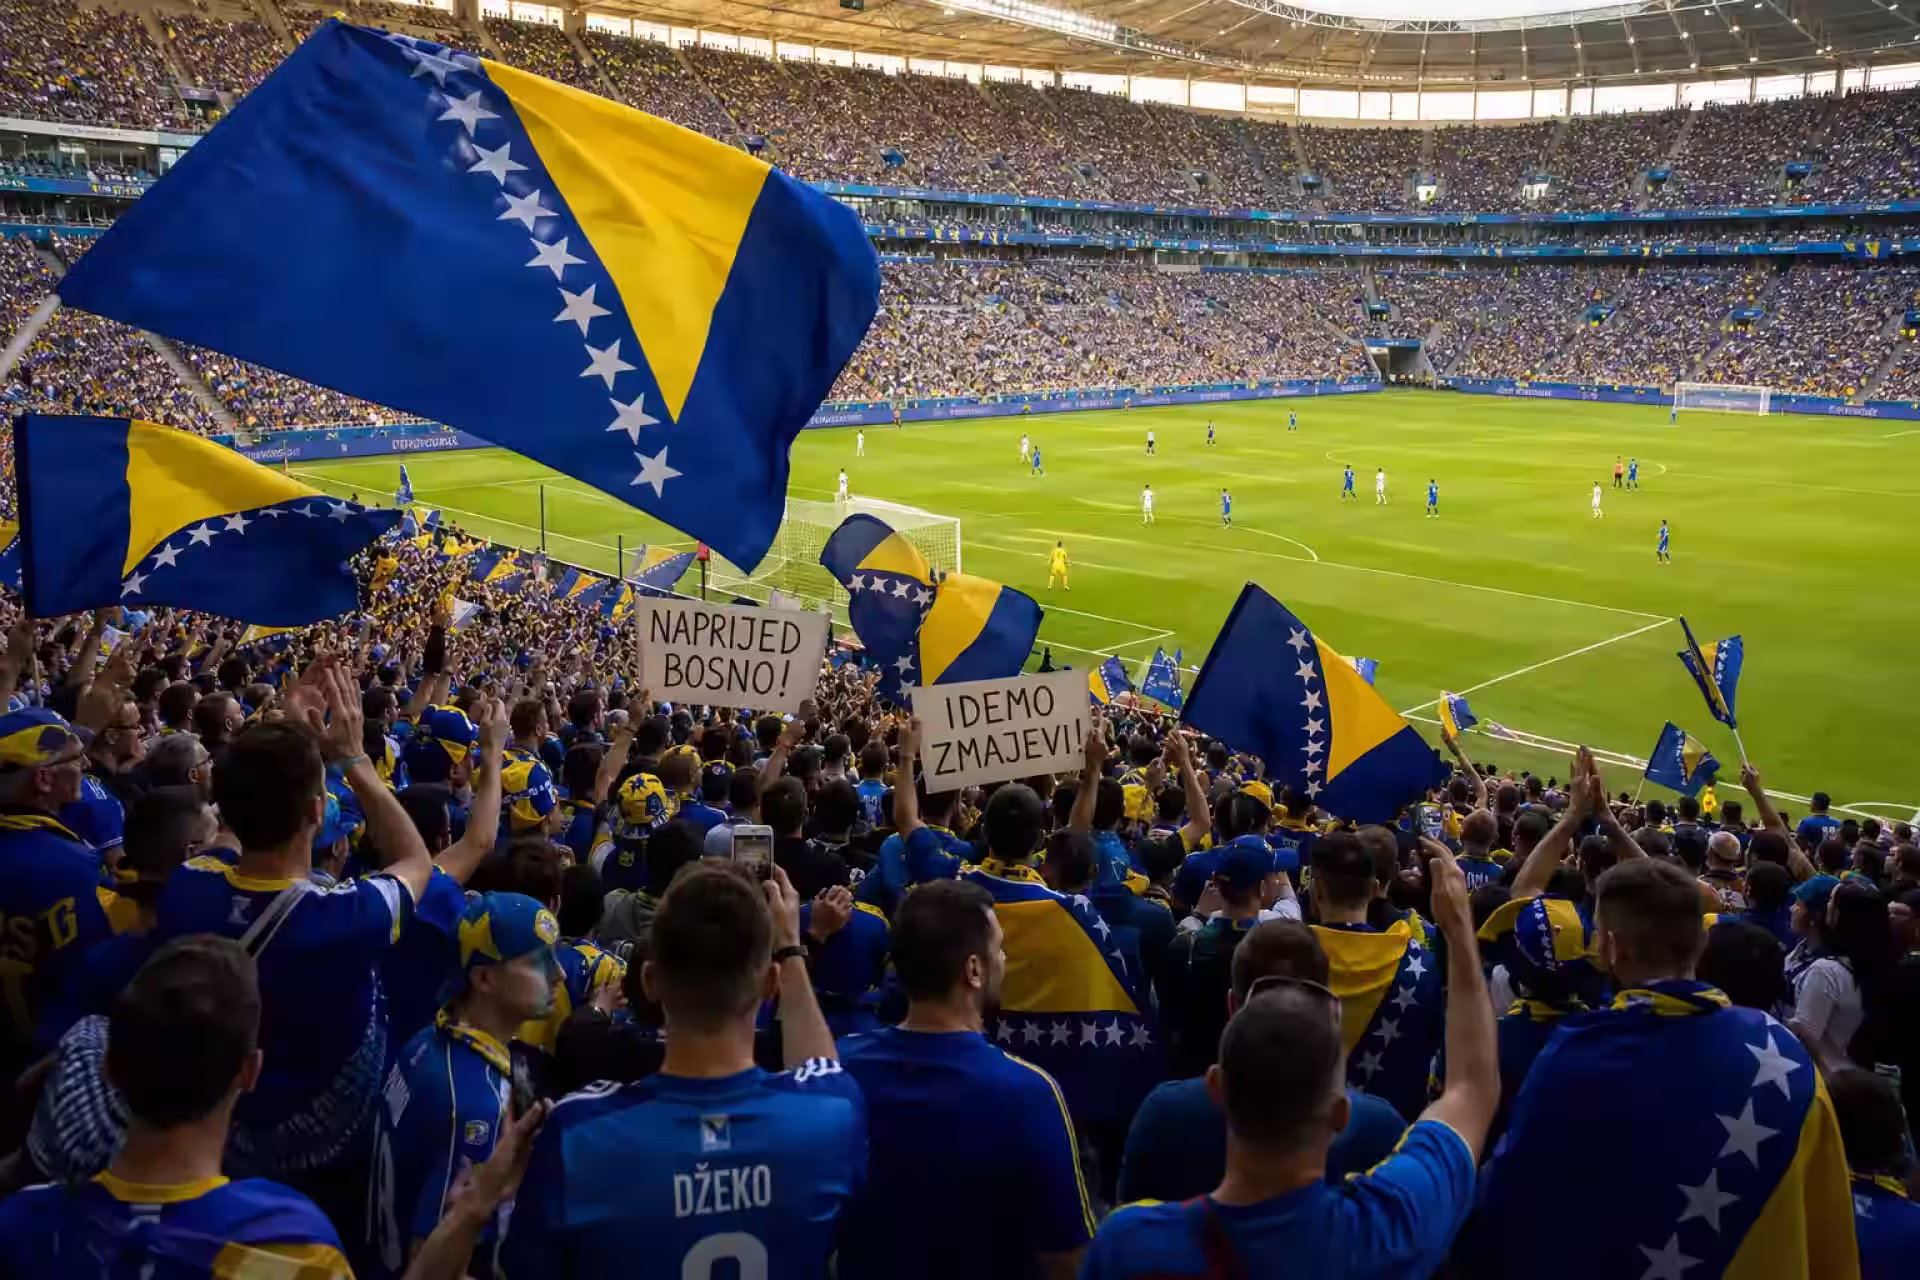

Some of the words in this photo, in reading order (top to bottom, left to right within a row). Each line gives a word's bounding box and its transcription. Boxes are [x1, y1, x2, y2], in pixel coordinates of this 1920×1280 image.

[650, 609, 801, 655] NAPRIJED
[663, 653, 791, 697] BOSNO!
[945, 685, 1054, 730] IDEMO
[931, 717, 1083, 776] ZMAJEVI!
[673, 1161, 772, 1218] DŽEKO
